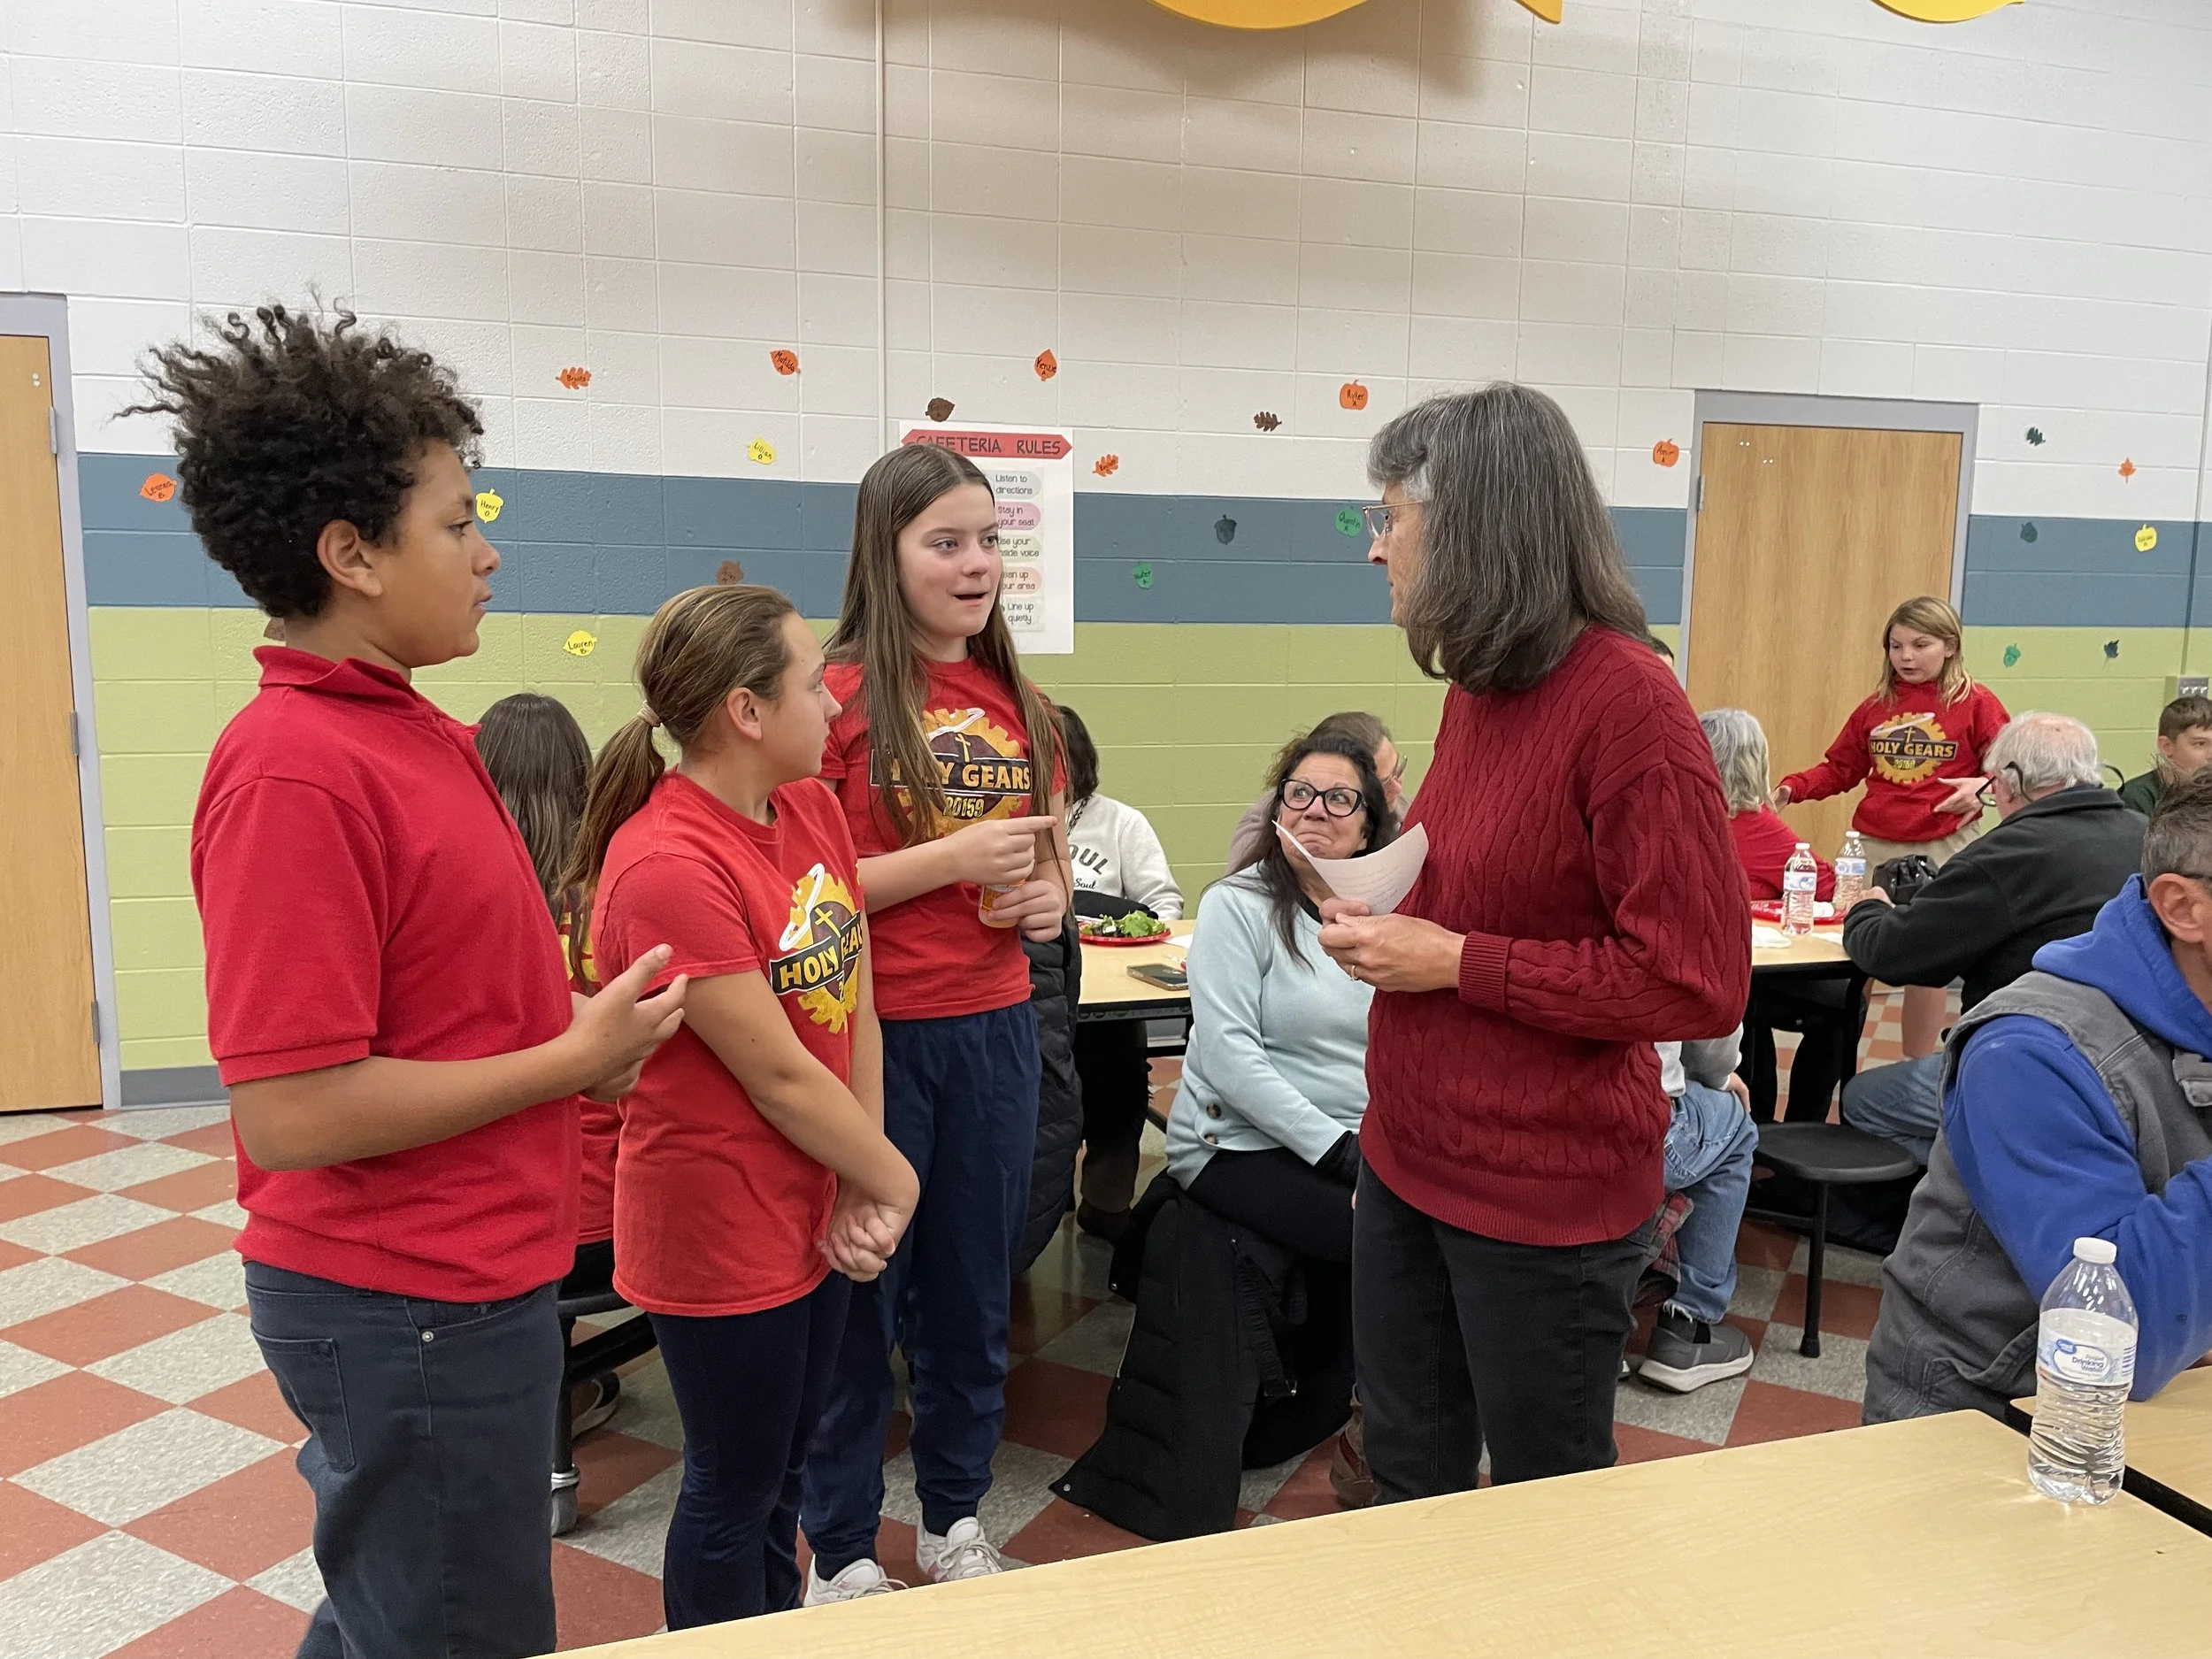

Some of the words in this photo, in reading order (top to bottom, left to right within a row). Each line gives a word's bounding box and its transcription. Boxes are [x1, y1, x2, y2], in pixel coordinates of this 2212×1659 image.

[774, 351, 795, 373] Matilda
[1017, 440, 1061, 455] RULES
[480, 498, 498, 513] Henry
[998, 506, 1015, 518] Stay
[998, 518, 1016, 528] your
[1012, 538, 1031, 548] your
[1019, 572, 1028, 581] up
[1025, 603, 1034, 613] up
[1008, 613, 1032, 625] quietly
[567, 640, 593, 650] Lauren
[1870, 741, 1901, 754] HOLY
[1903, 742, 1954, 757] GEARS
[962, 764, 1031, 790] GEARS
[943, 796, 985, 818] 20159
[1075, 878, 1096, 889] Soul
[780, 945, 839, 989] HOLY
[2072, 1356, 2104, 1368] Drinking
